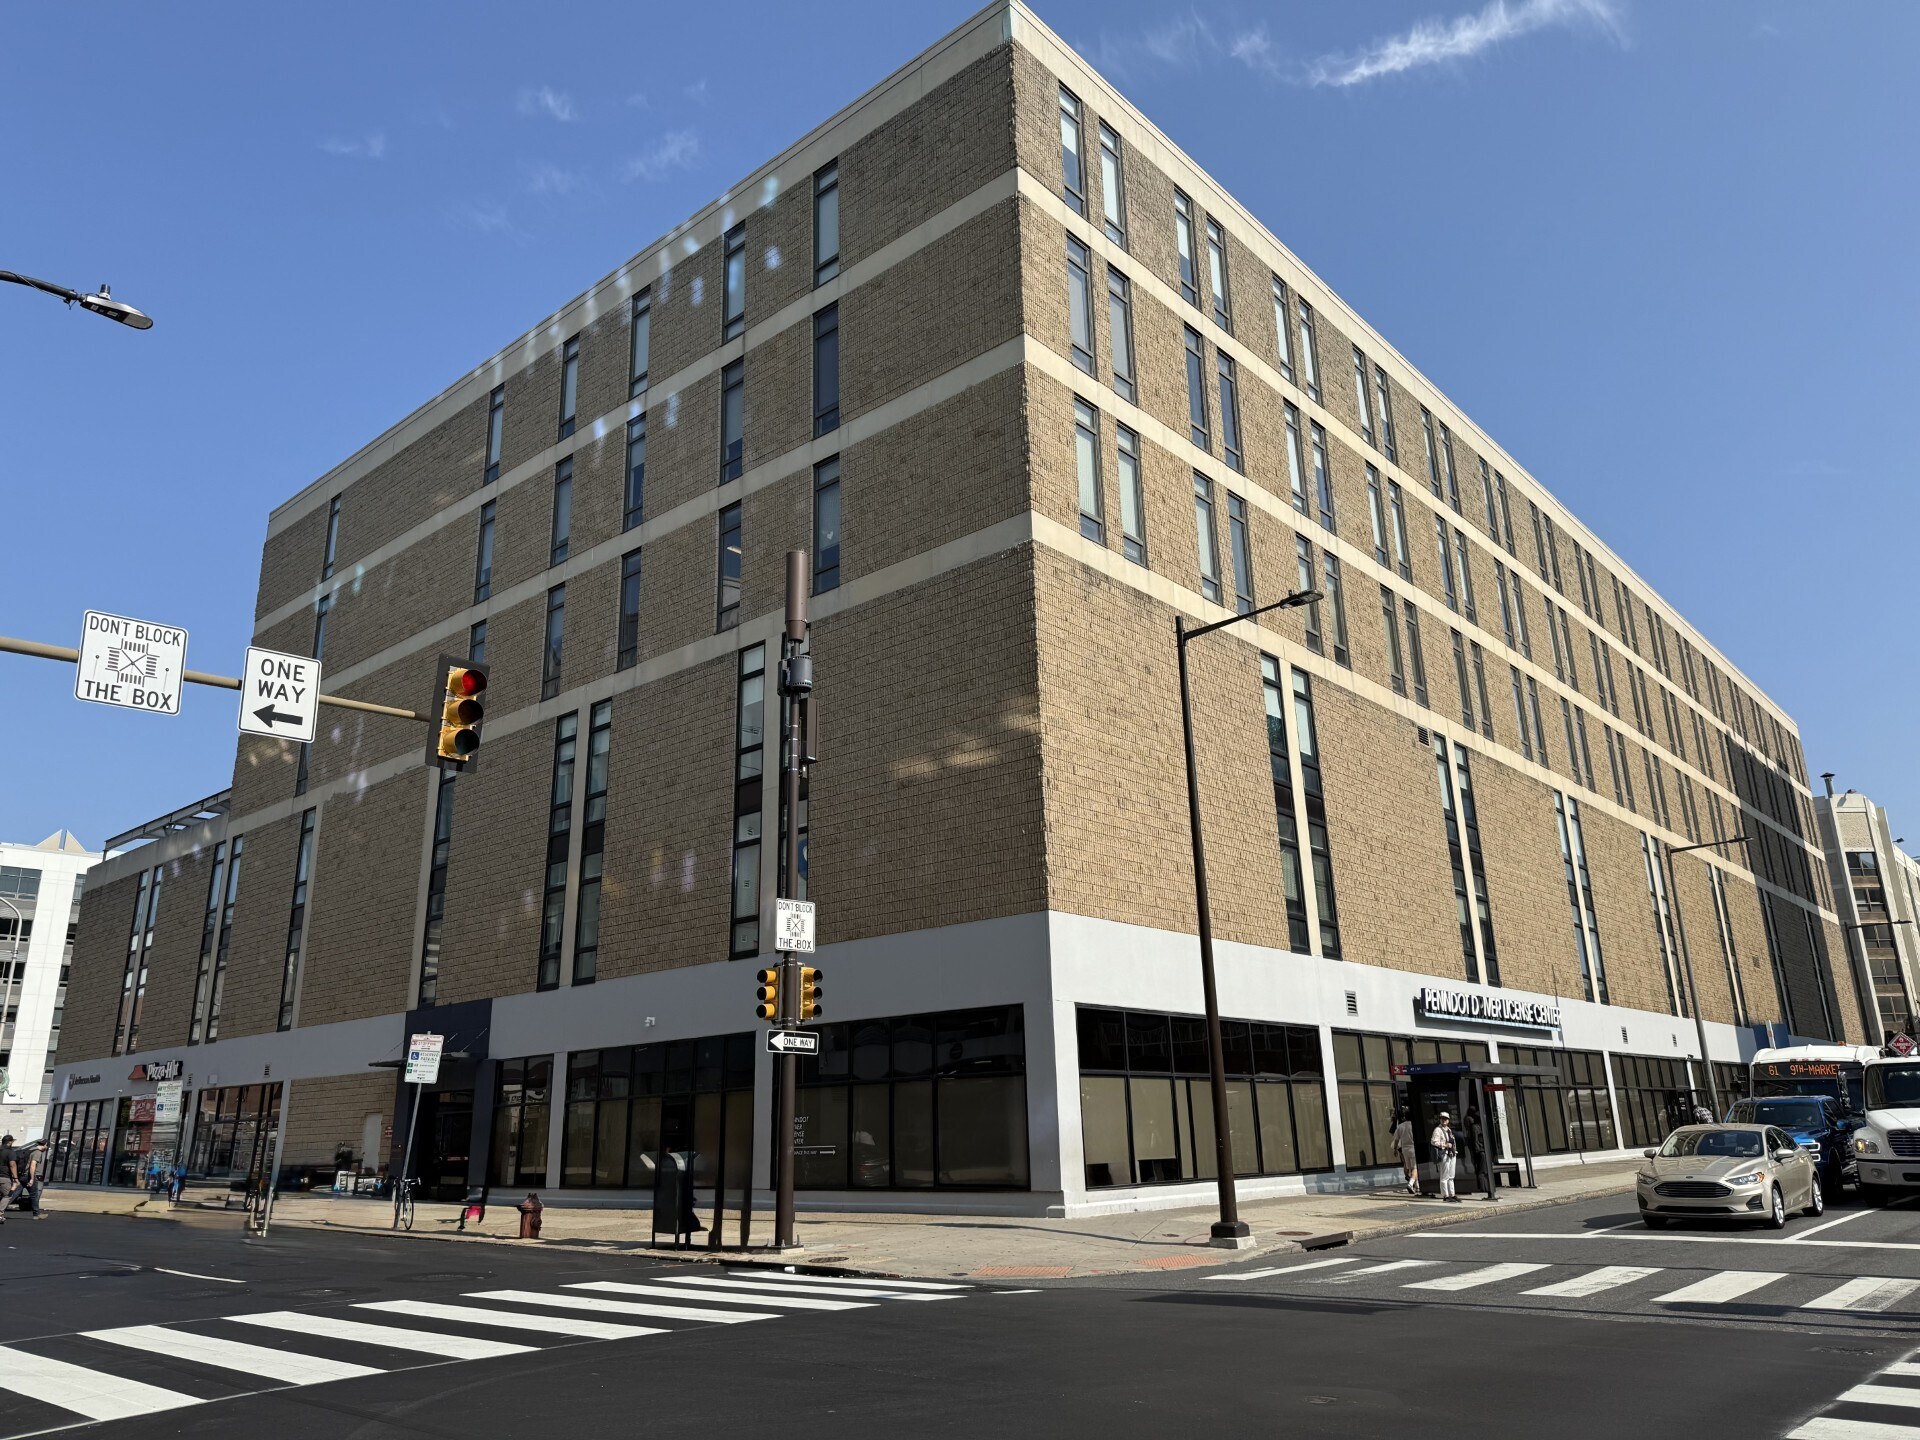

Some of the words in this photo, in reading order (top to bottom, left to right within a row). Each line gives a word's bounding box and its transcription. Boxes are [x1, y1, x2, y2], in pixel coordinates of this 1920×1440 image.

[89, 615, 131, 637] DON'T
[135, 624, 181, 647] BLOCK
[260, 658, 305, 683] ONE
[84, 679, 123, 702] THE
[132, 688, 172, 711] BOX
[258, 678, 307, 704] WAY
[778, 937, 793, 948] THE
[796, 939, 812, 950] BOX
[1424, 987, 1470, 1015] PENNDOT
[1502, 998, 1534, 1022] LICENSE
[1533, 1003, 1561, 1026] CENTER
[783, 1037, 798, 1047] ONE
[799, 1038, 813, 1048] WAY
[147, 1061, 165, 1081] Pizza
[165, 1060, 180, 1080] Ht
[1768, 1065, 1779, 1076] 61
